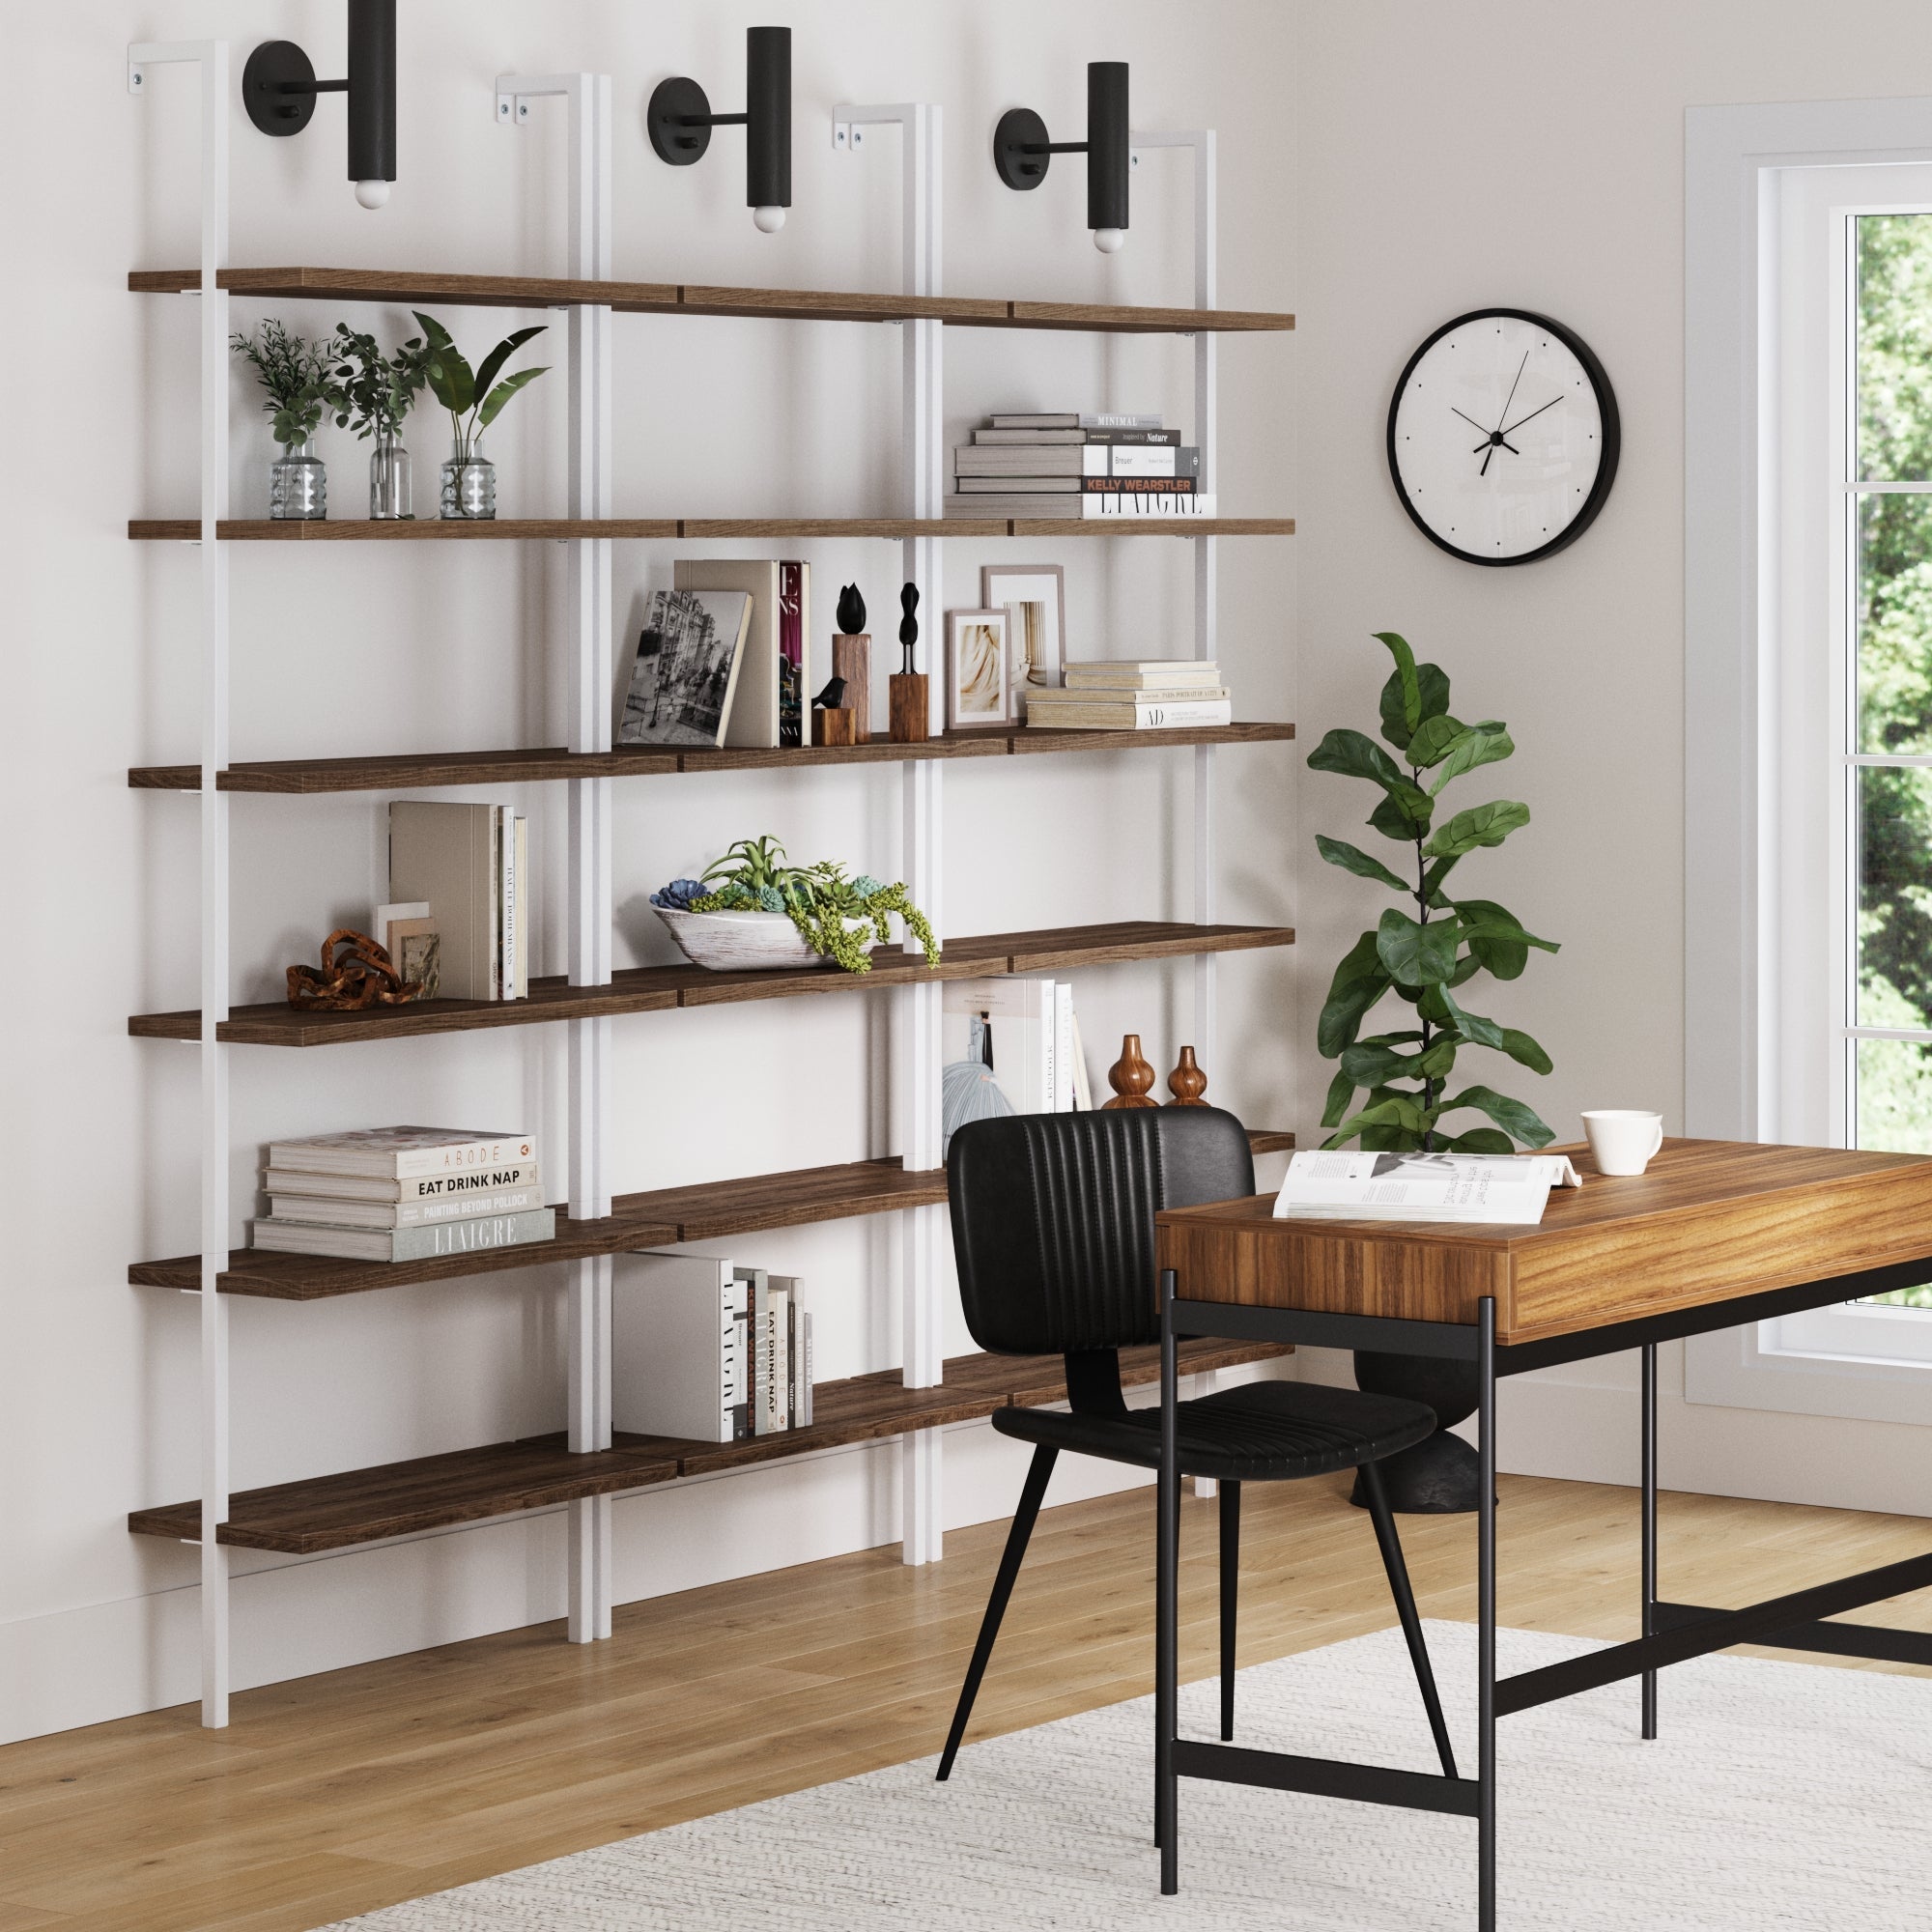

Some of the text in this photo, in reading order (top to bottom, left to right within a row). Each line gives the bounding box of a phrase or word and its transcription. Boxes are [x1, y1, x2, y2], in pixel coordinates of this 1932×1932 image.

[1097, 416, 1138, 426] MINIMAL
[1146, 432, 1168, 442] Nature
[1115, 456, 1133, 465] Breuer
[1087, 478, 1191, 492] KELLY WEARSTLER
[418, 1180, 443, 1196] EAT
[447, 1174, 489, 1191] DRINK
[493, 1170, 520, 1185] NAP
[424, 1202, 460, 1219] PAINTING
[461, 1197, 493, 1214] BEYOND
[494, 1193, 527, 1209] POLLOCK
[435, 1217, 518, 1255] LIAIGRE
